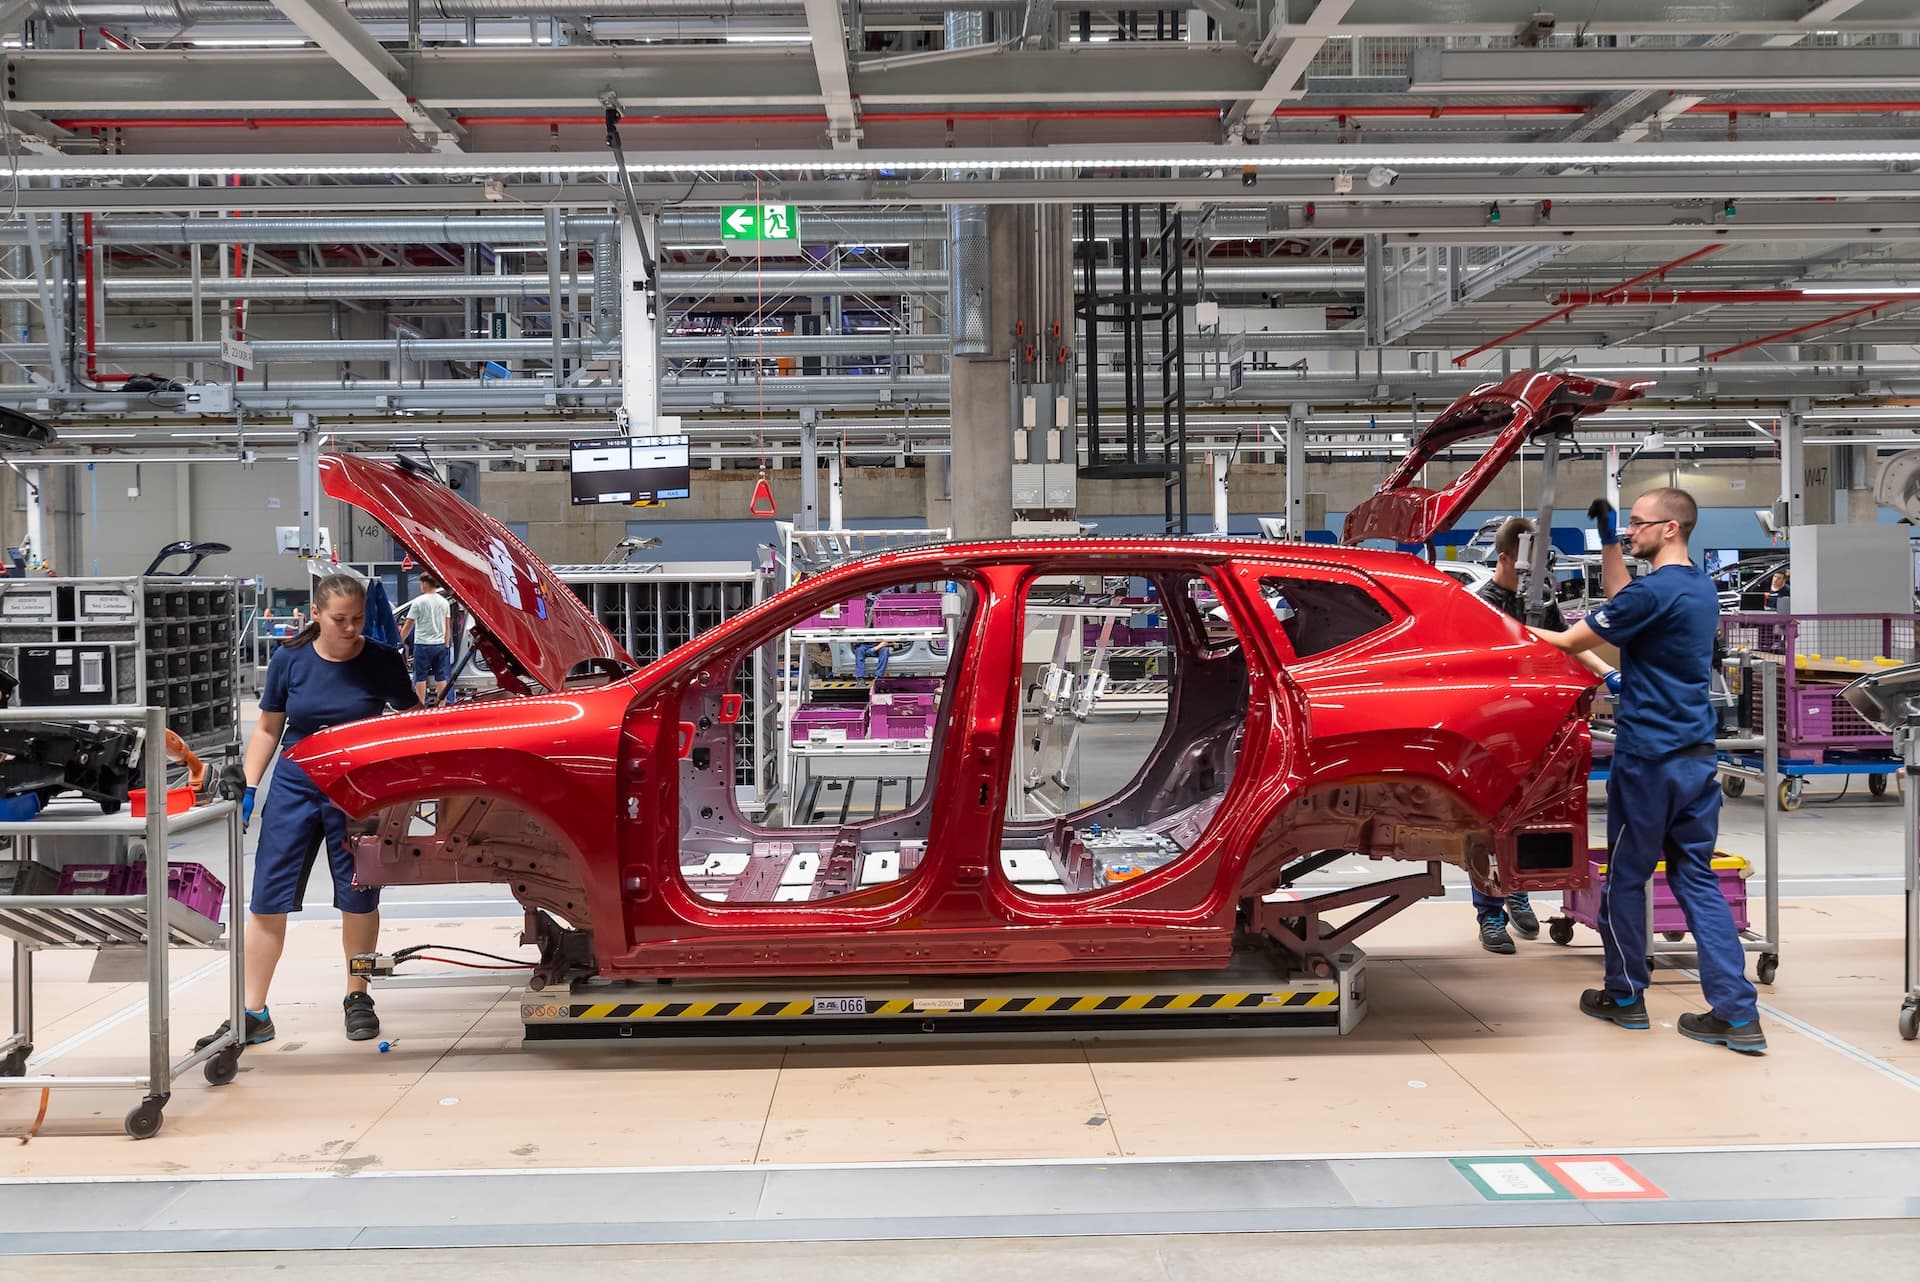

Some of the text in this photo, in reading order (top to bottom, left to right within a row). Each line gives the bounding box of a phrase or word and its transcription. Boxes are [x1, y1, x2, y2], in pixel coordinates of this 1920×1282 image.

[1805, 467, 1827, 487] W47
[358, 525, 379, 538] Y46
[840, 999, 863, 1012] 066
